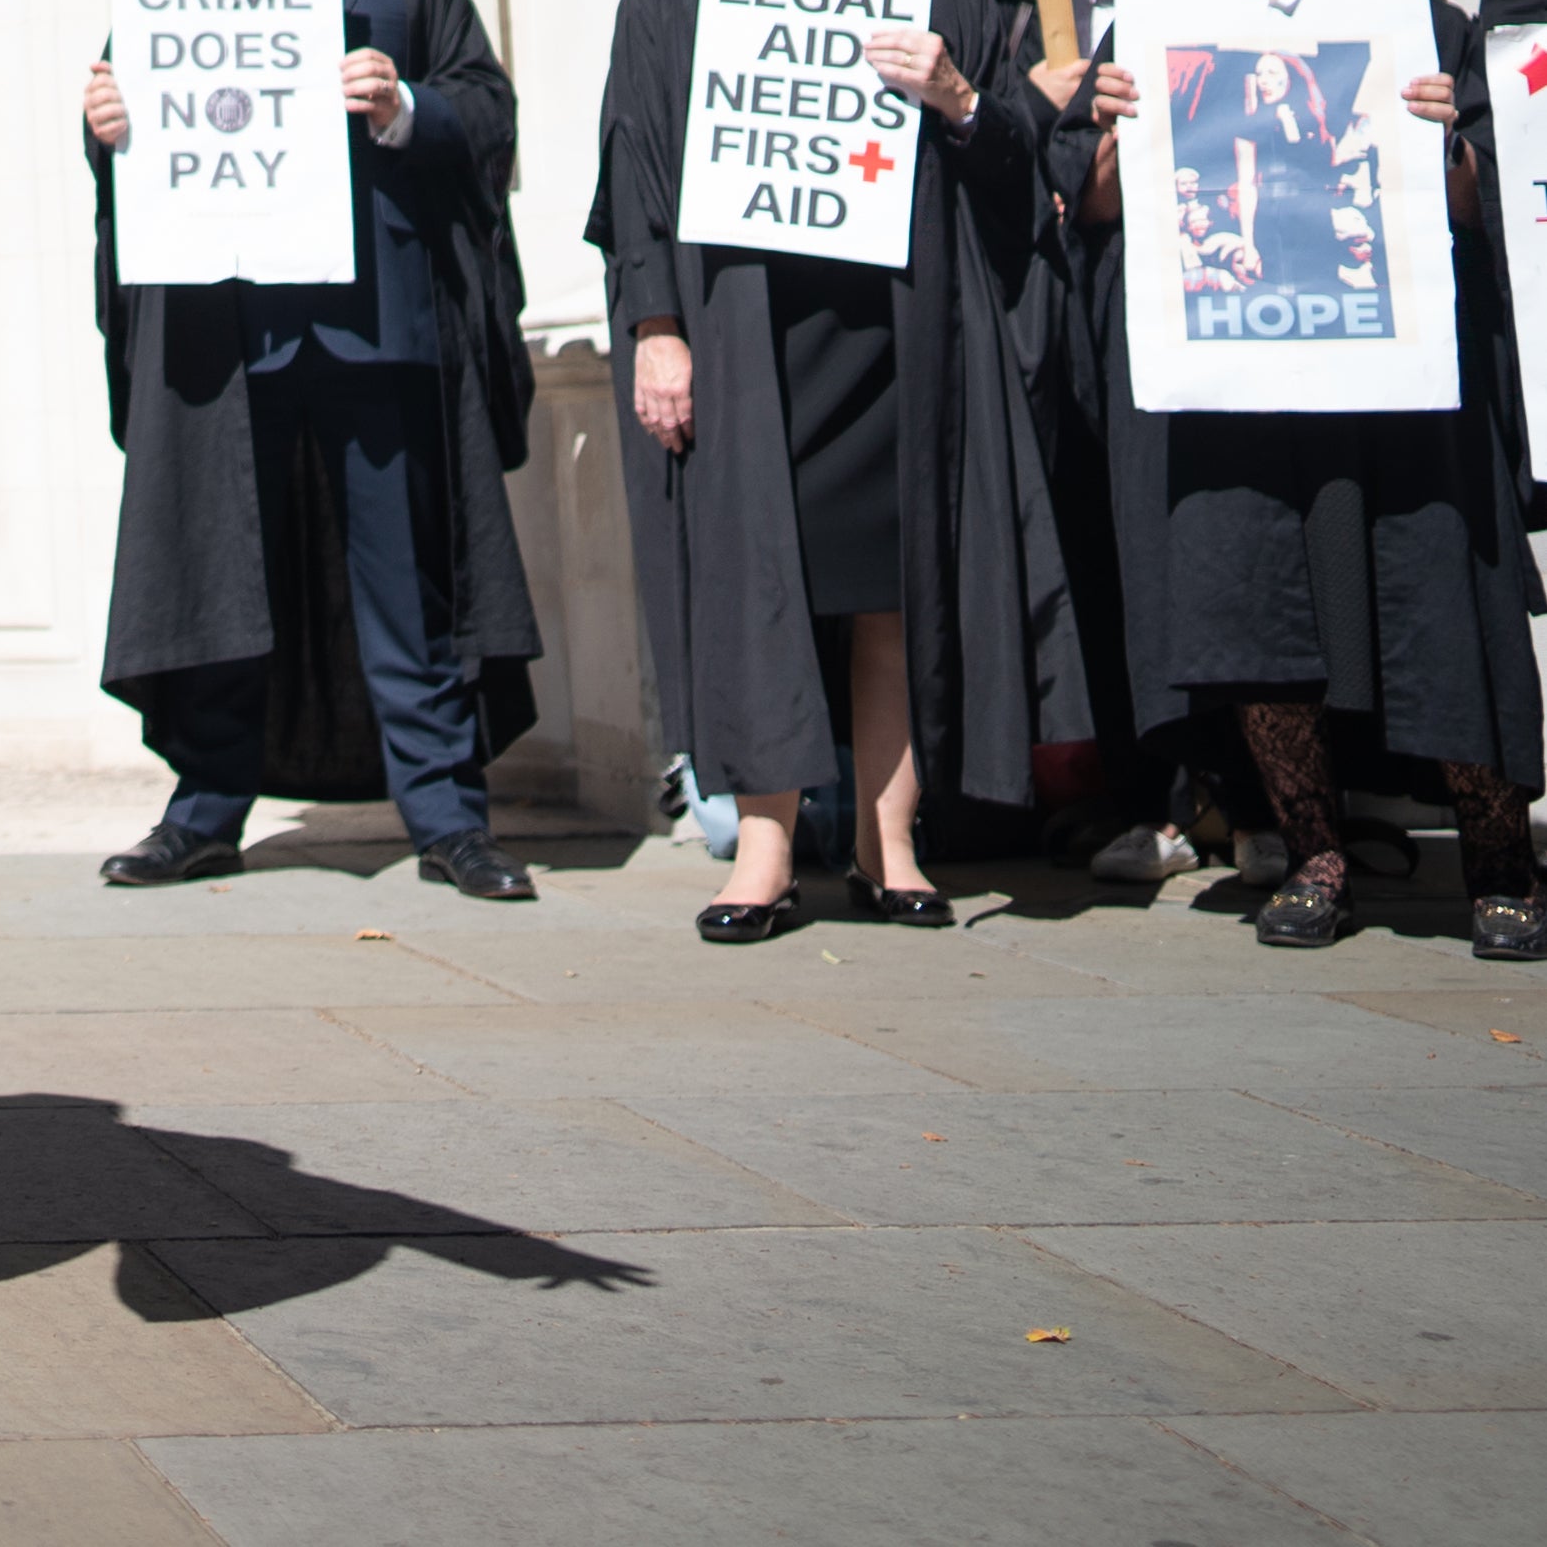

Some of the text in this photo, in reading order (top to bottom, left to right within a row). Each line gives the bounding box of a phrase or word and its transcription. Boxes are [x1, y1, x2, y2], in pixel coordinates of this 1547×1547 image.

[150, 31, 302, 71] DOES
[757, 22, 865, 69] AID
[705, 70, 908, 131] NEEDS
[169, 150, 287, 189] PAY
[741, 182, 848, 229] AID
[1197, 292, 1384, 336] HOPE
